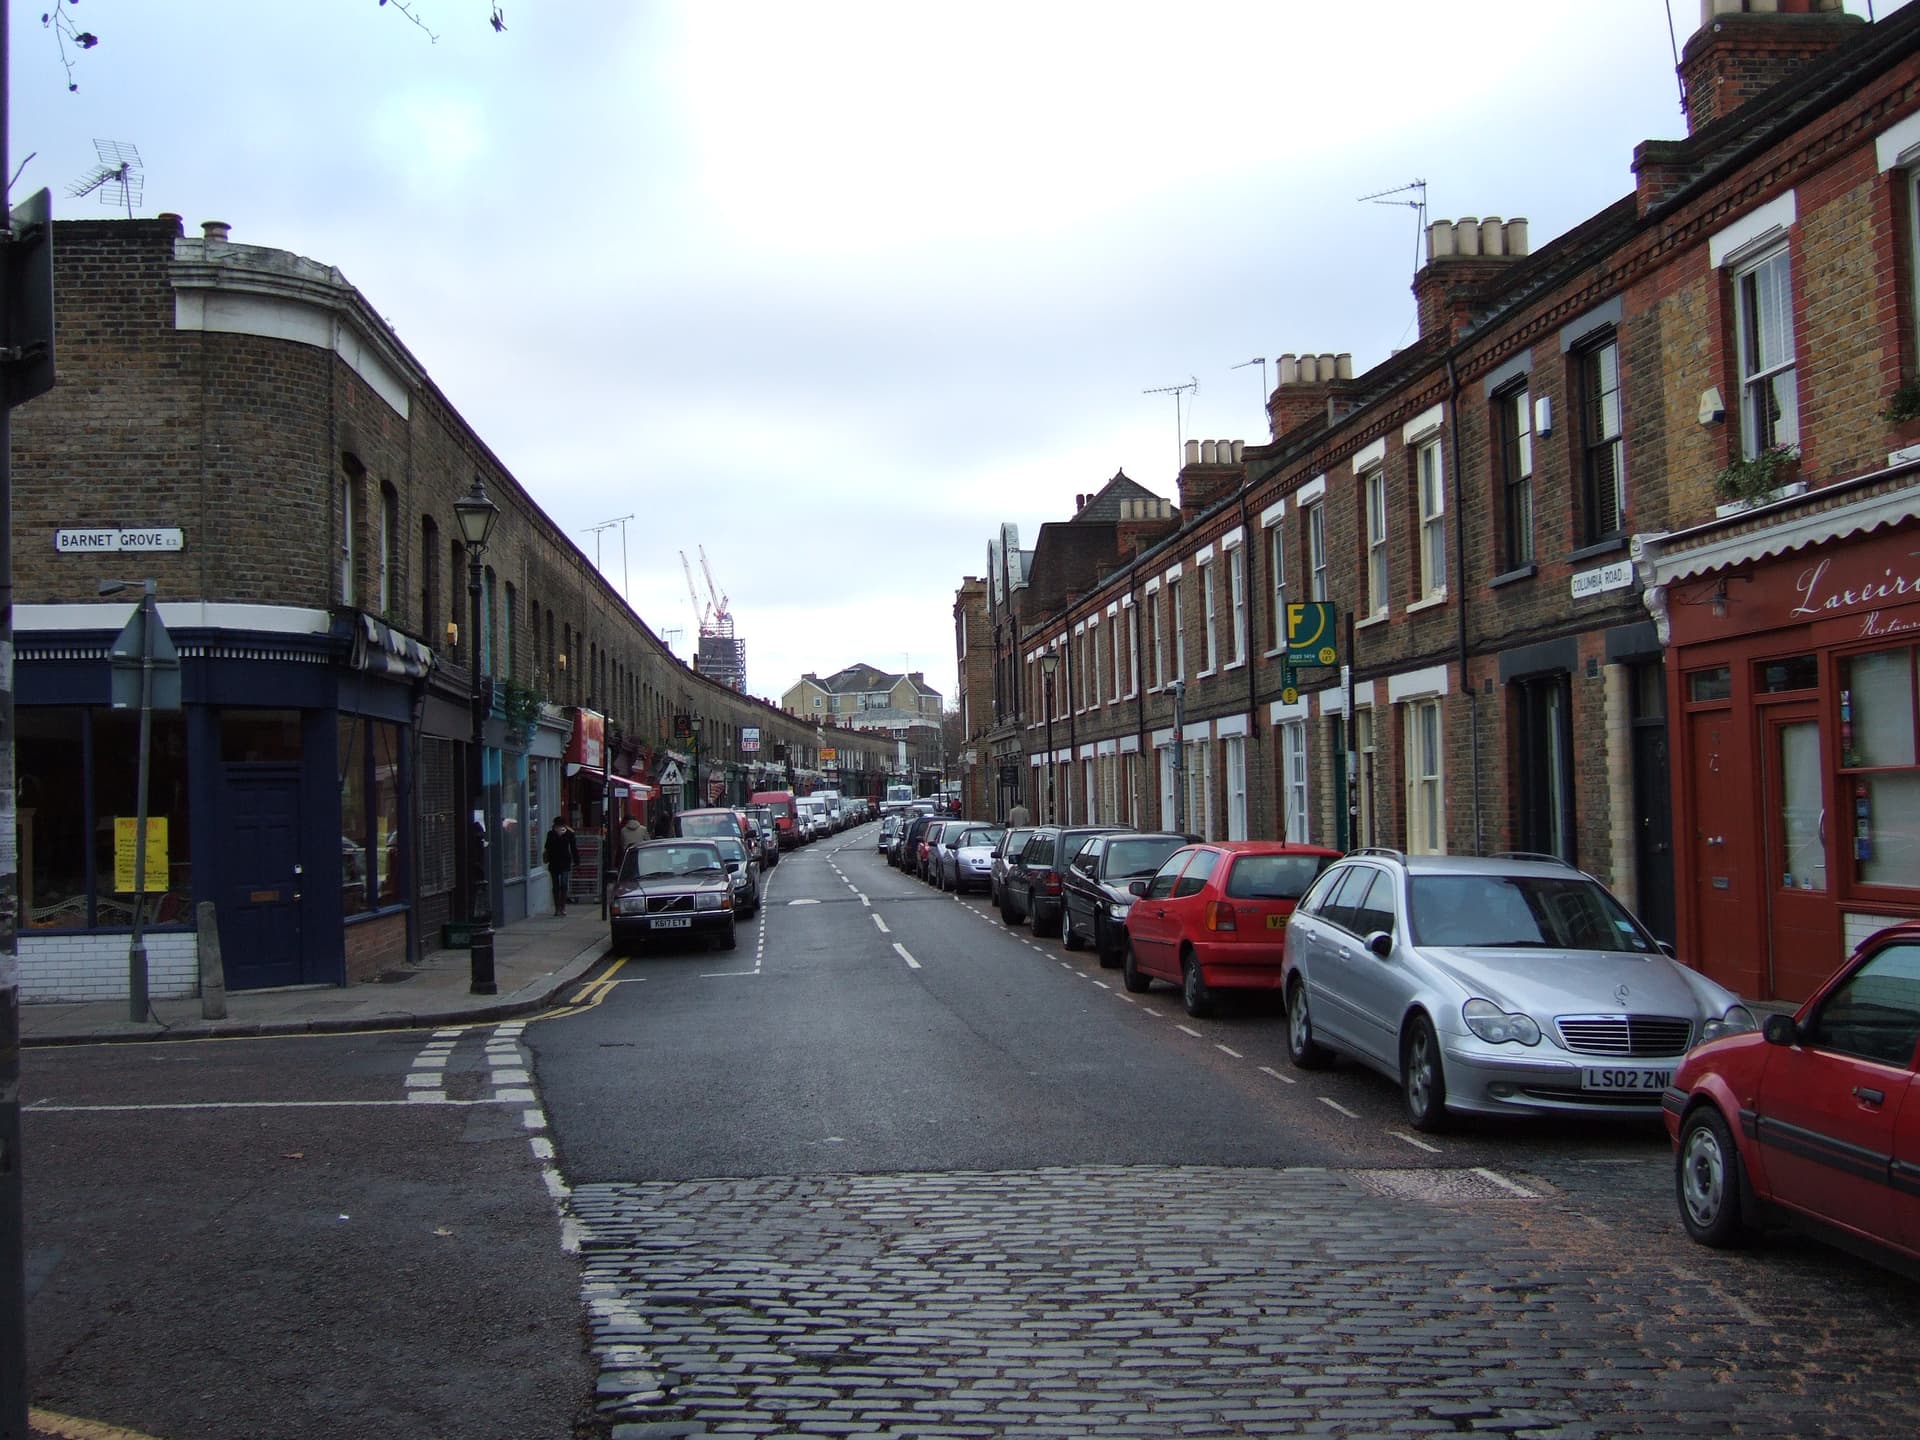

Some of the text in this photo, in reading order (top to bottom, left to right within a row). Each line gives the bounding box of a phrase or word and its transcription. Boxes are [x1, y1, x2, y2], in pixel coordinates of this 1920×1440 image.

[61, 534, 113, 547] BARNET
[120, 534, 162, 546] GROVE
[1574, 573, 1603, 592] COLUMBIA
[1605, 568, 1623, 584] ROAD
[1589, 1069, 1638, 1088] LS02
